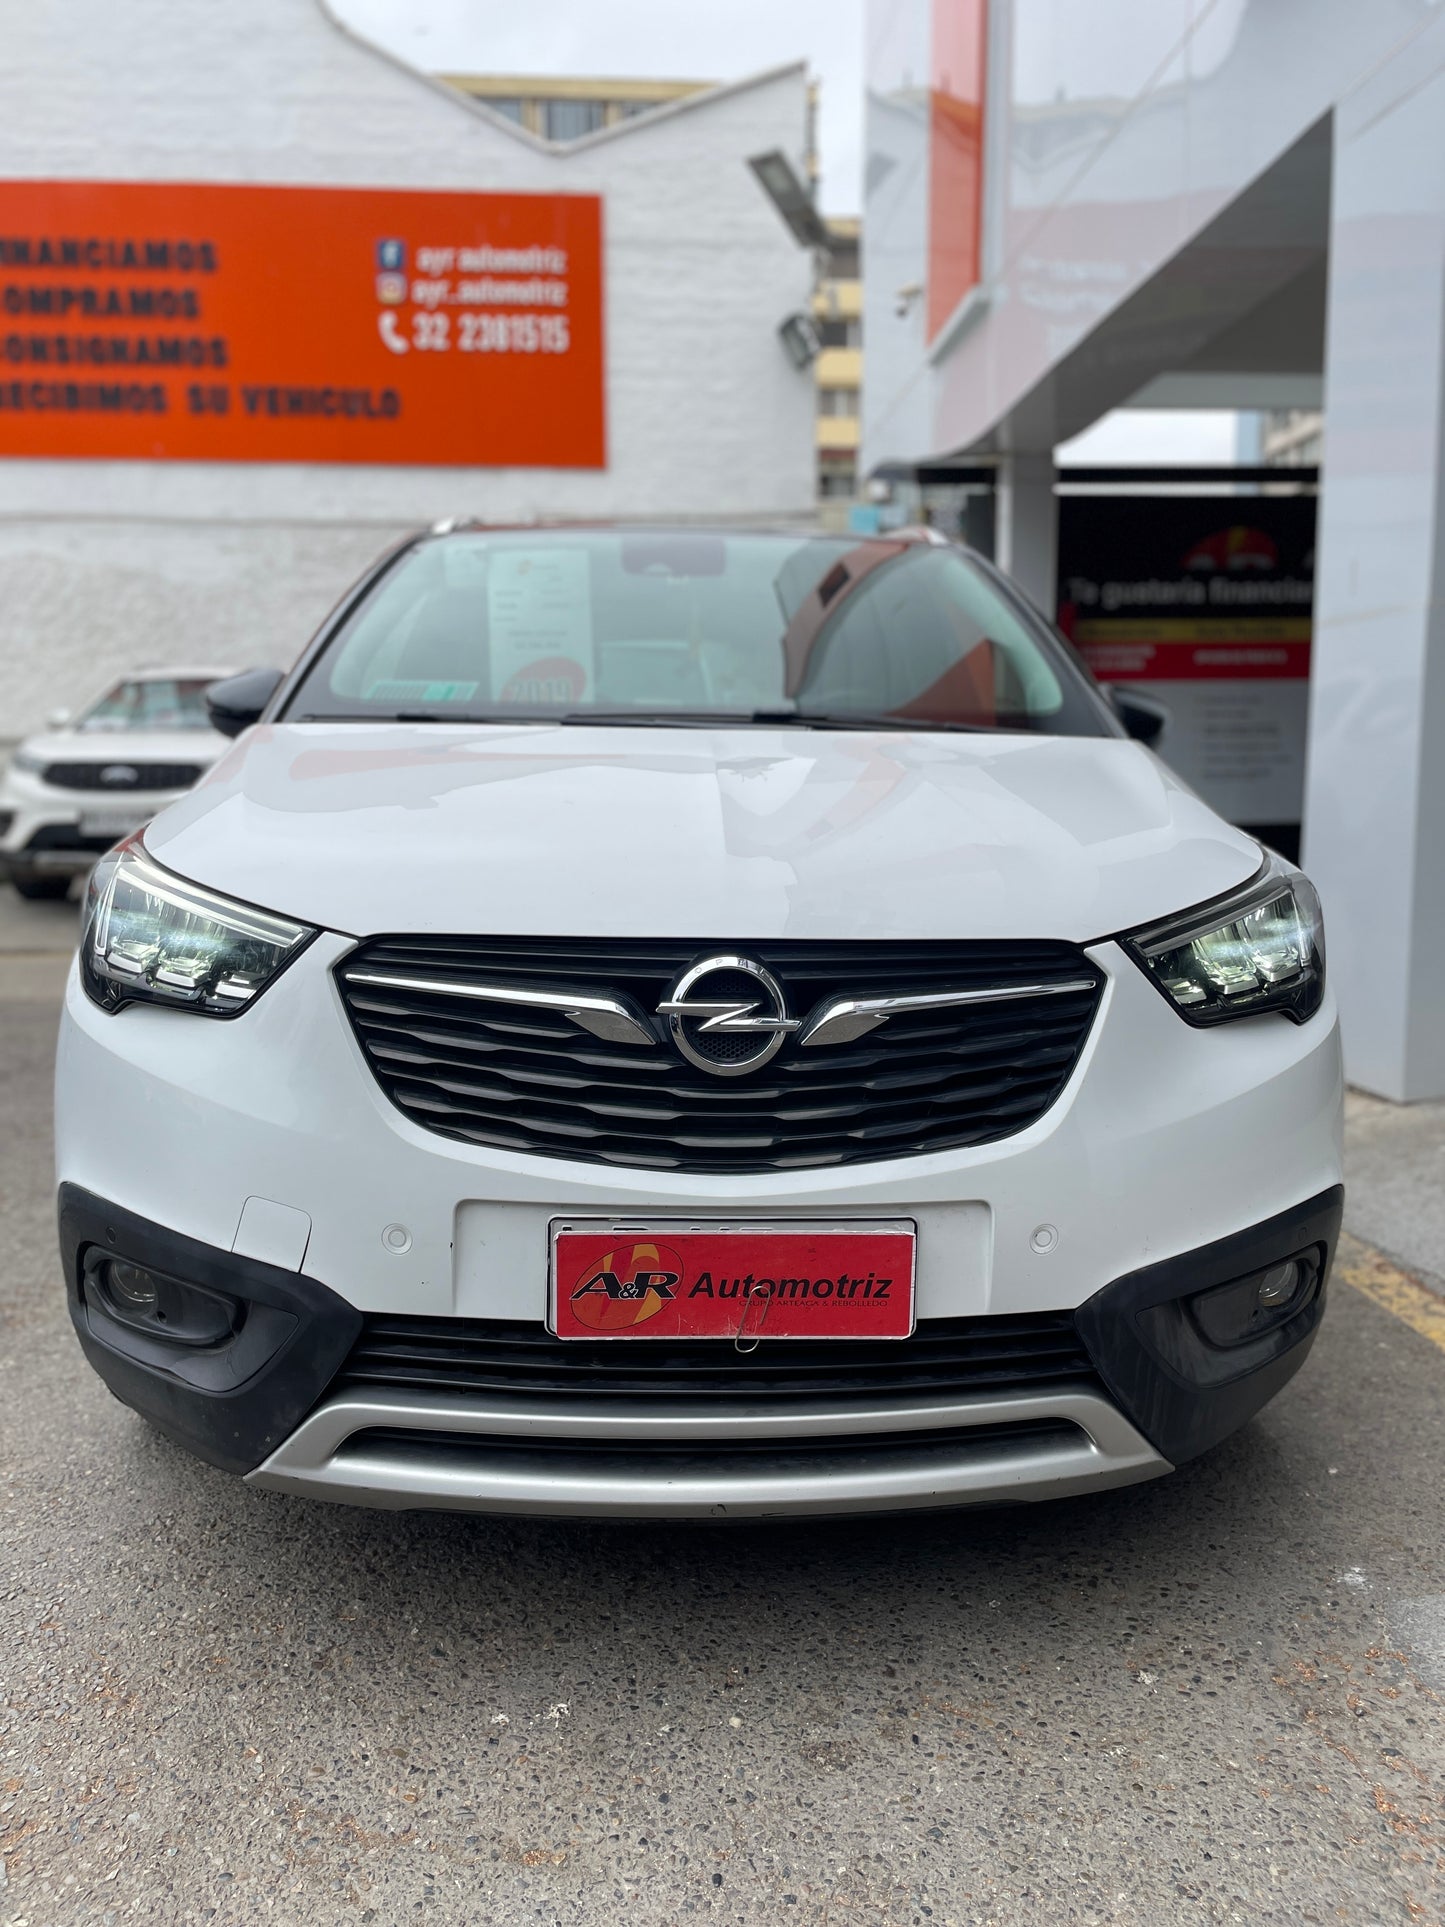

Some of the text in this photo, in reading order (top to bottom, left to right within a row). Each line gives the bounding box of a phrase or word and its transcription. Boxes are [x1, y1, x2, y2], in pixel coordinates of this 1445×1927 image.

[412, 311, 449, 351] 32
[0, 381, 167, 413] ECIBIMOS
[187, 383, 230, 415] SU
[569, 1271, 894, 1300] A&R Automotriz
